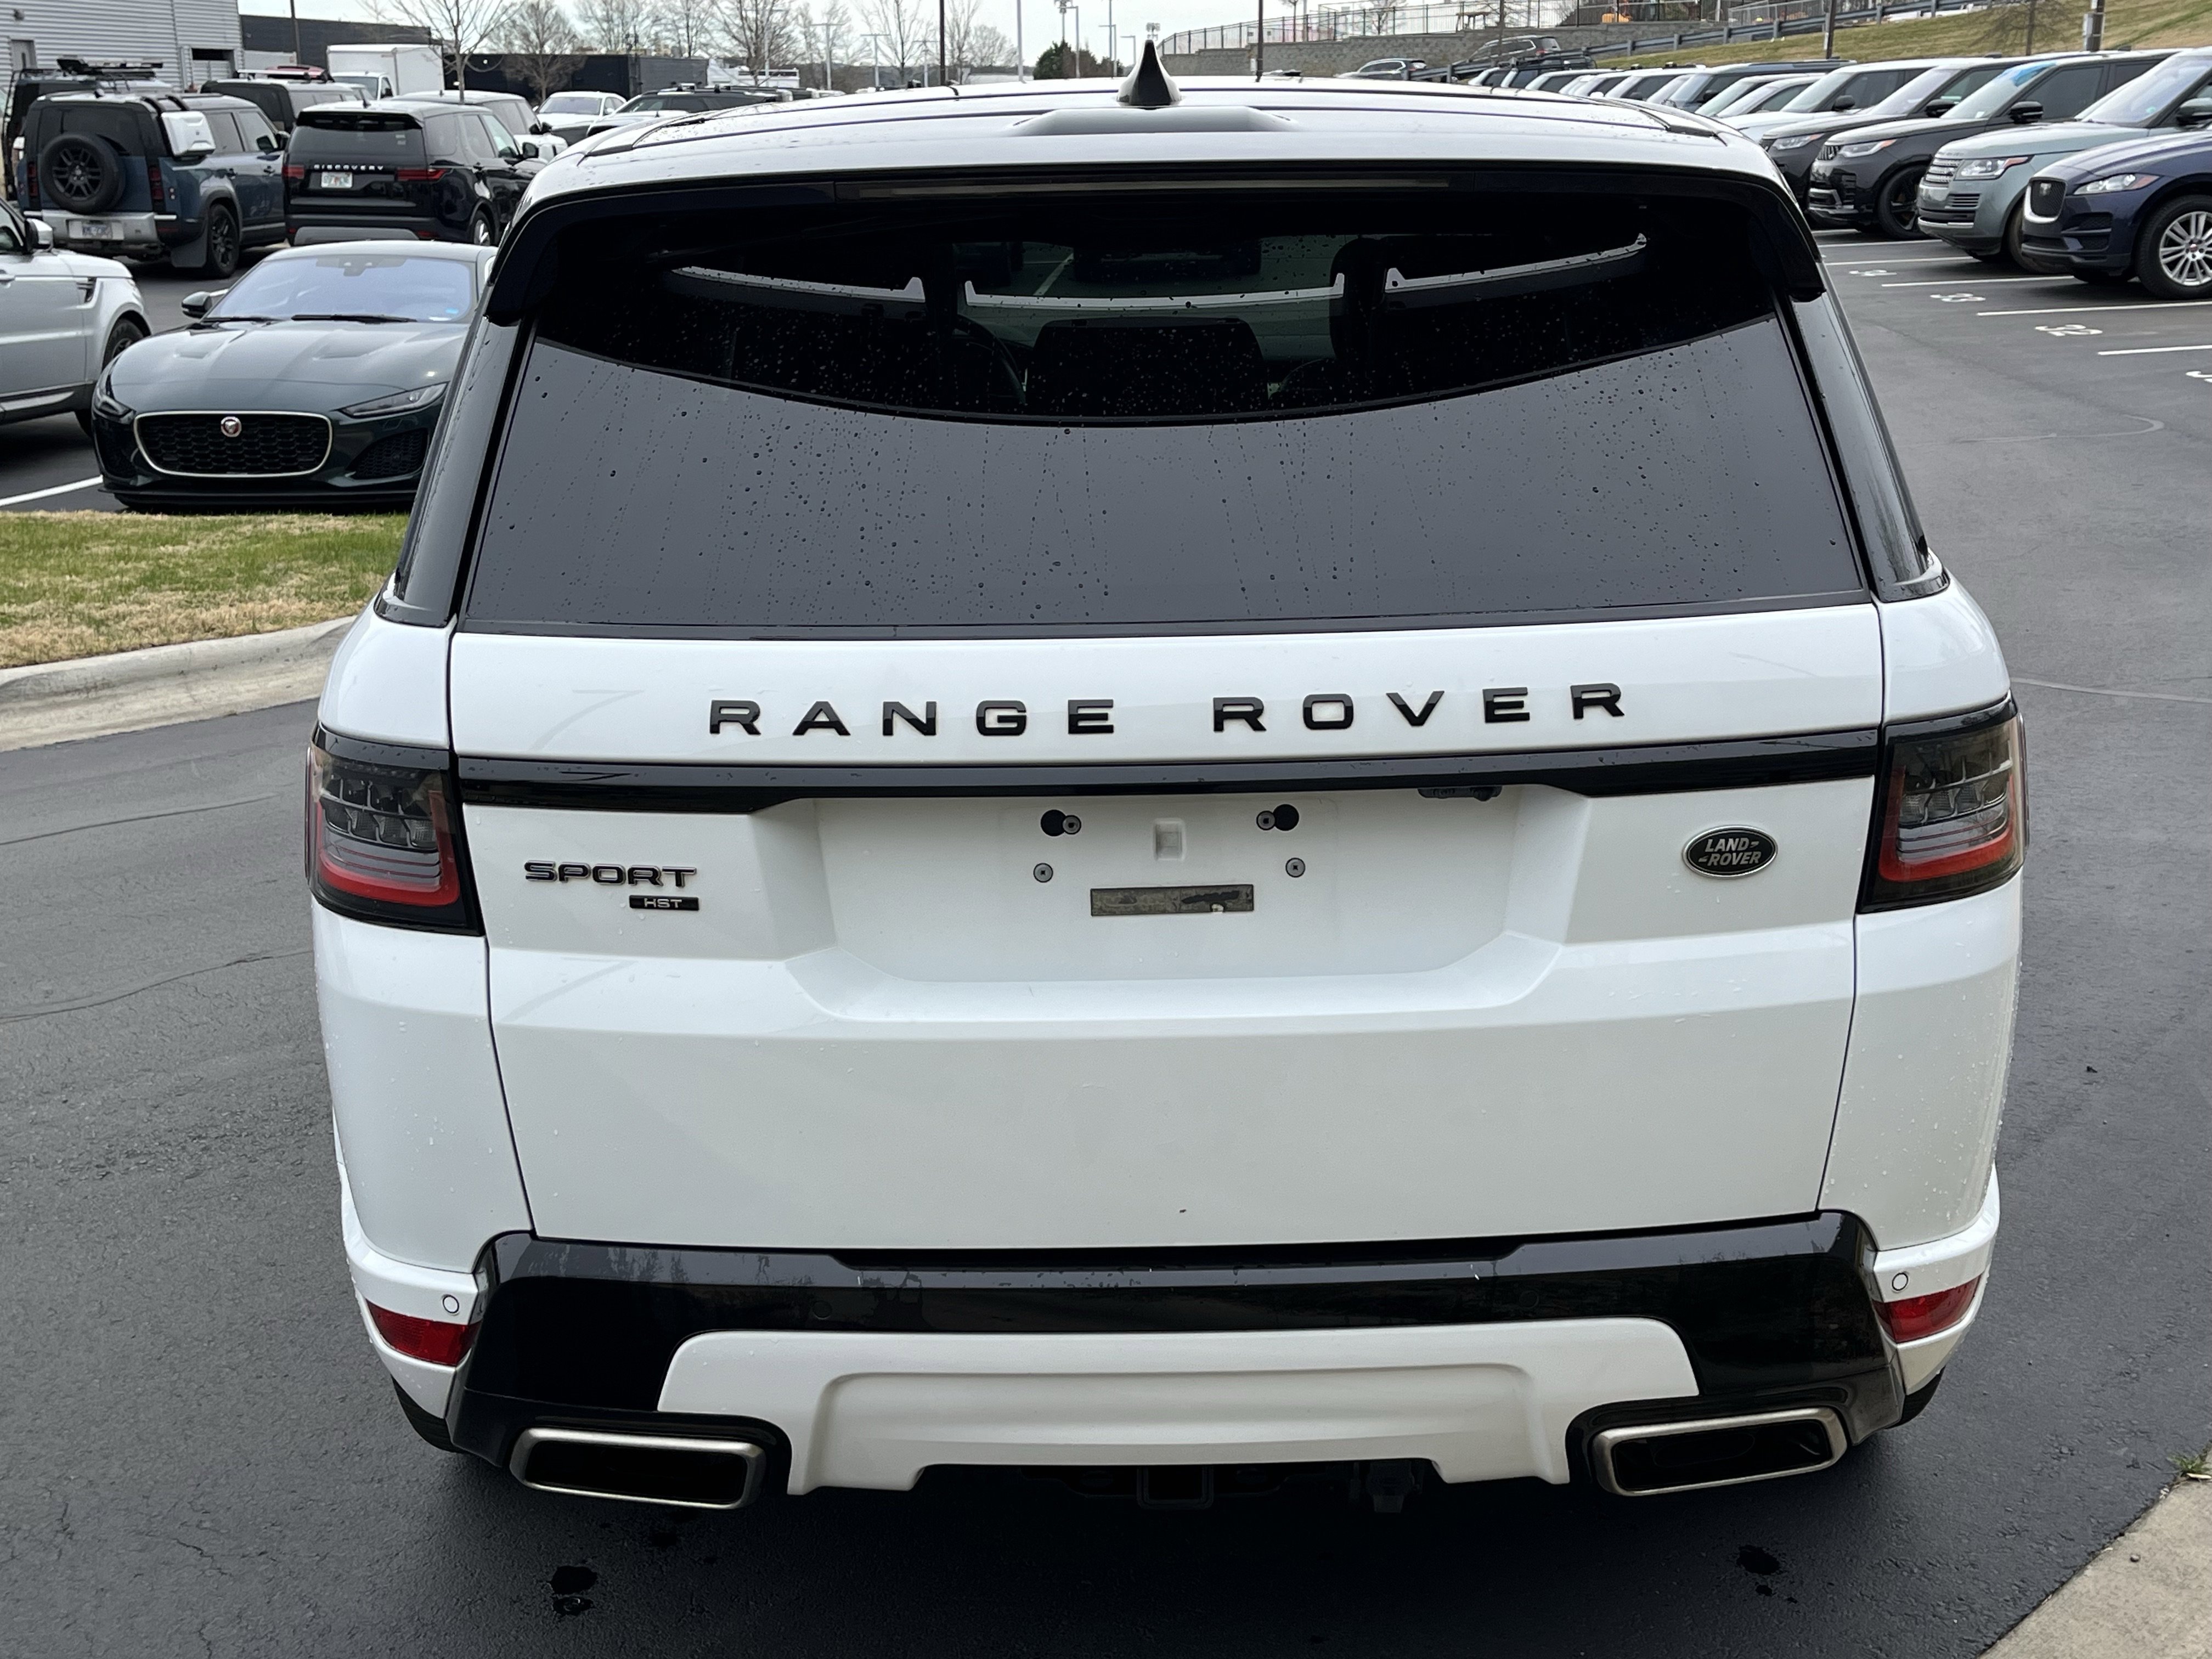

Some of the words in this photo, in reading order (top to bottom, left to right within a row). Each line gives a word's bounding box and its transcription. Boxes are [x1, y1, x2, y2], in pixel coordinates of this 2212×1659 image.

[709, 698, 1114, 737] RANGE
[1212, 682, 1625, 732] ROVER
[1707, 851, 1762, 866] ROVER
[524, 860, 697, 888] SPORT
[644, 898, 682, 909] HST
